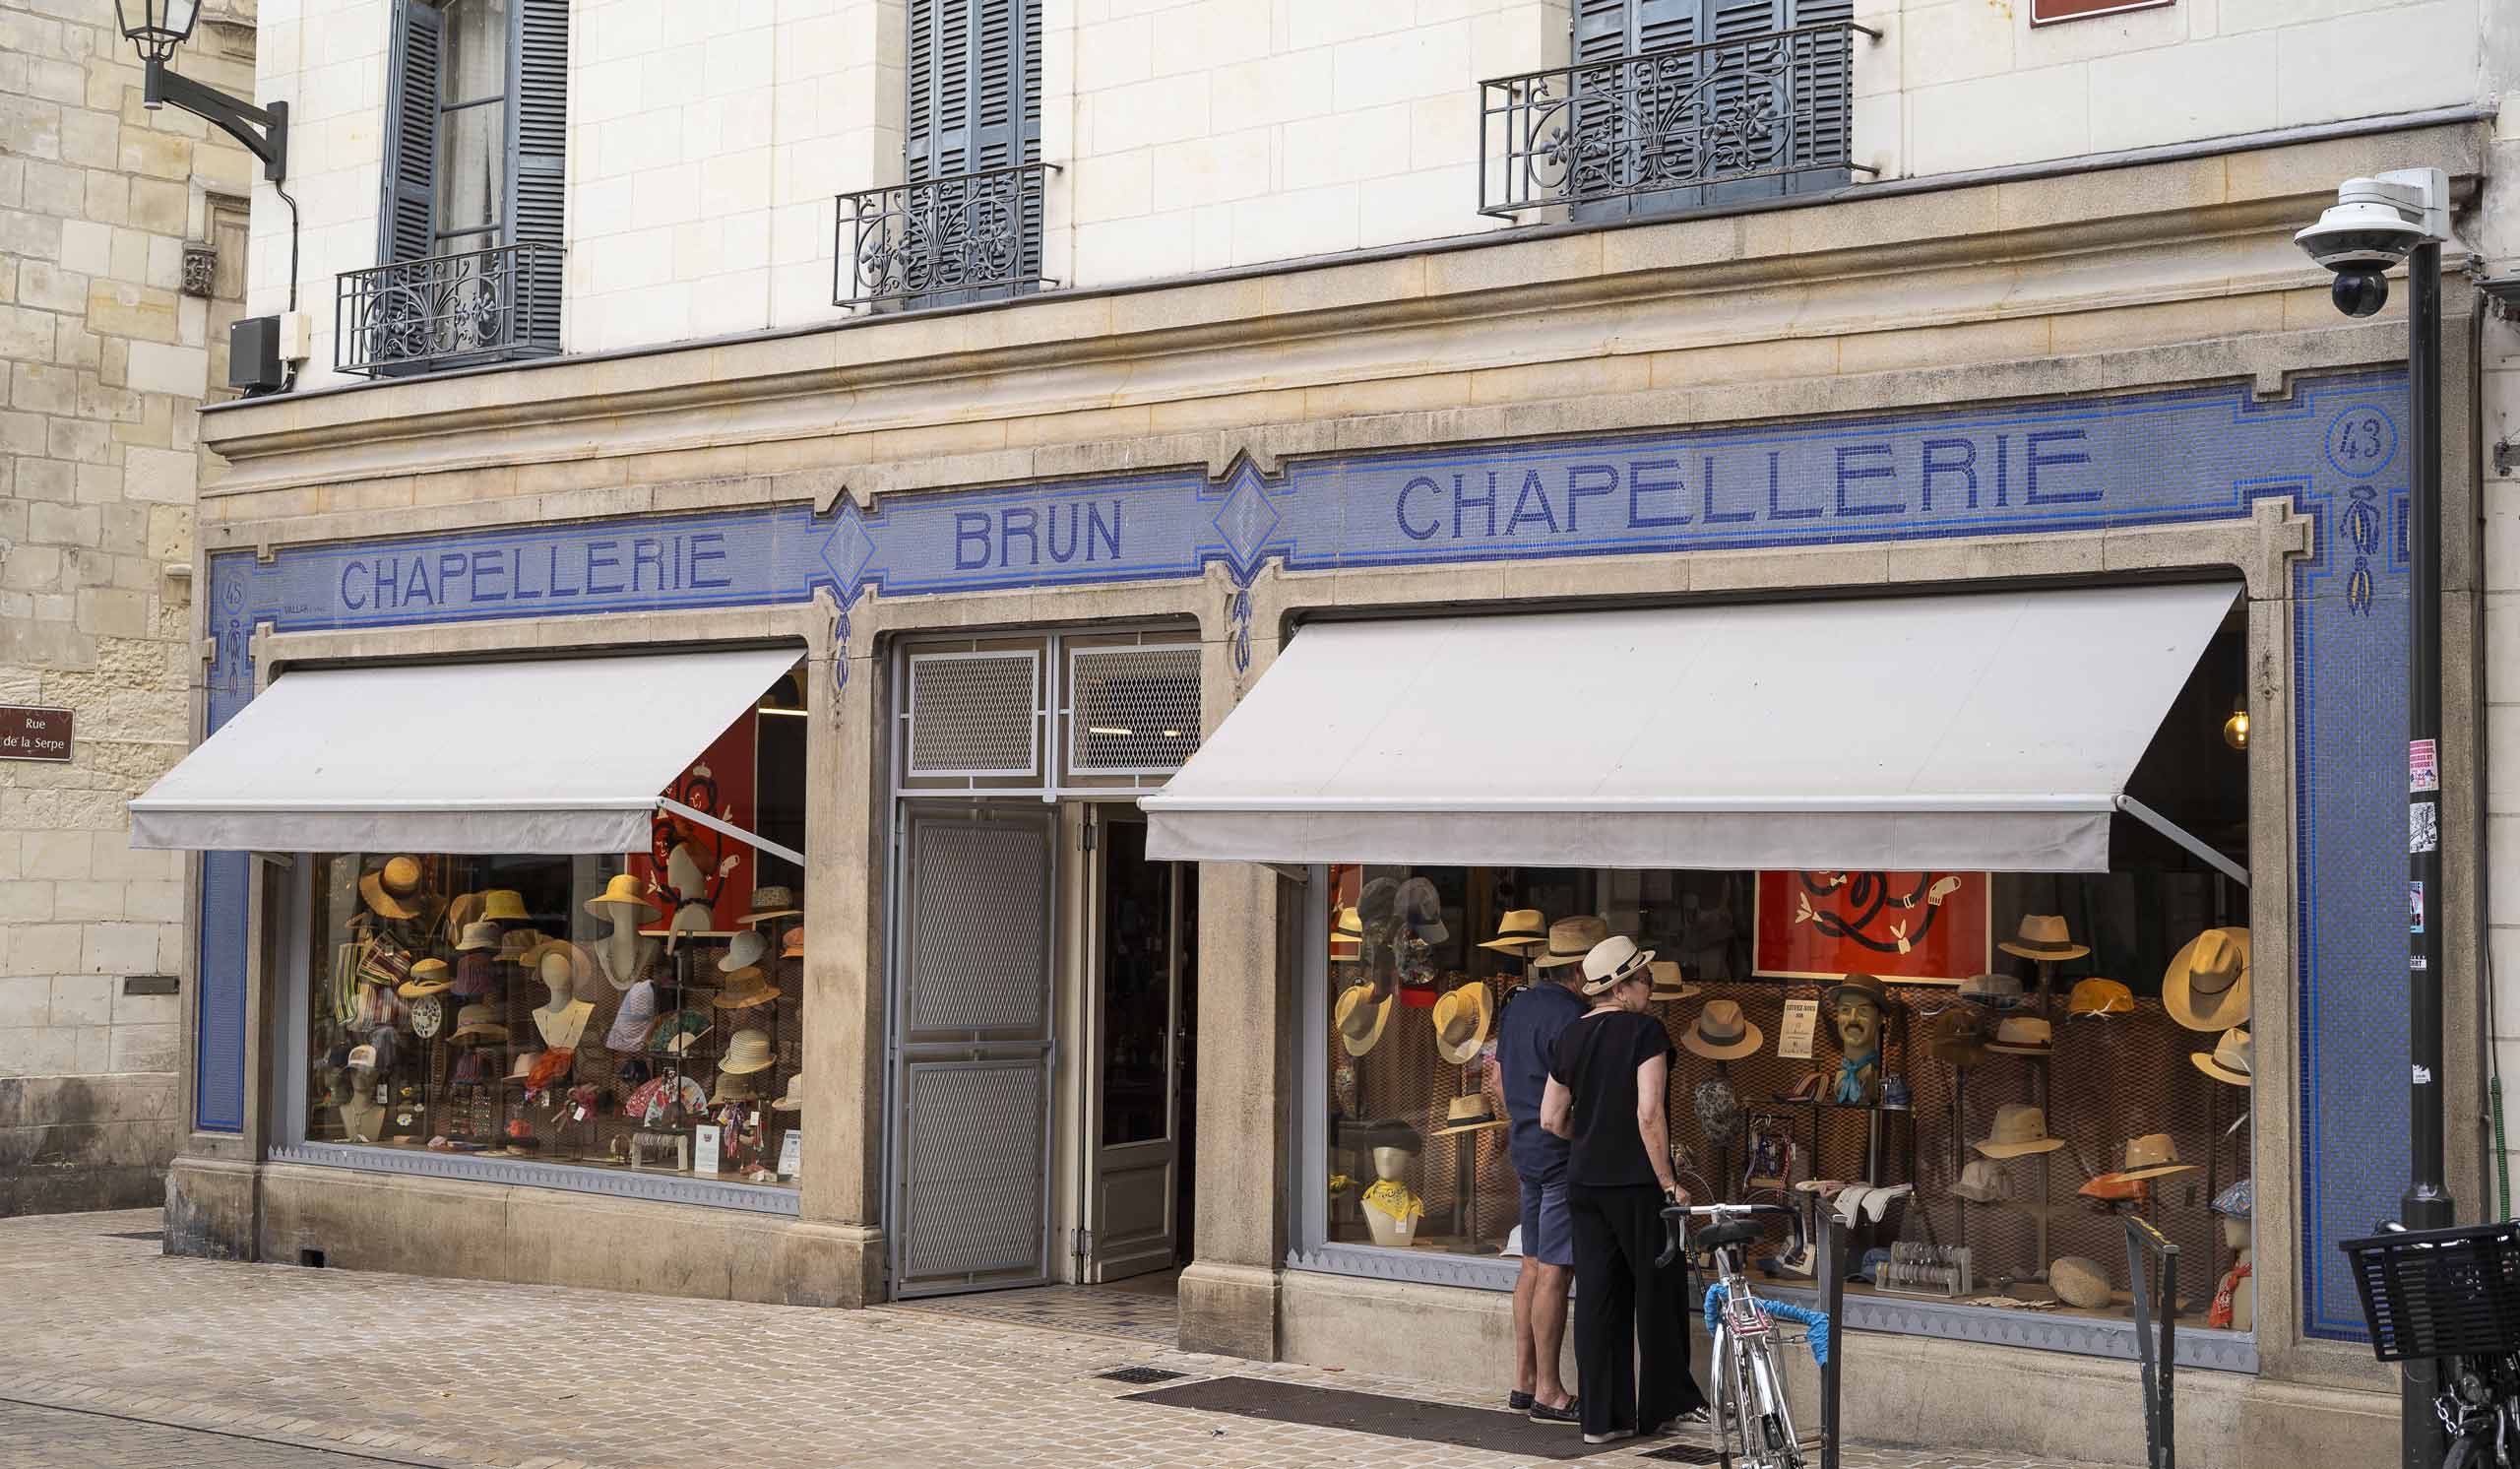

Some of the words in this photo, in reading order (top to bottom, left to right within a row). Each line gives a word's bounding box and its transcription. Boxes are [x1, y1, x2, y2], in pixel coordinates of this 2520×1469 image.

[2340, 417, 2380, 459] 43
[341, 534, 731, 610] CHAPELLERIE
[954, 499, 1121, 570] BRUN
[1396, 428, 2105, 540] CHAPELLERIE
[26, 718, 46, 730] Rue
[3, 735, 18, 747] de
[21, 735, 31, 748] la
[34, 737, 64, 752] Serpe
